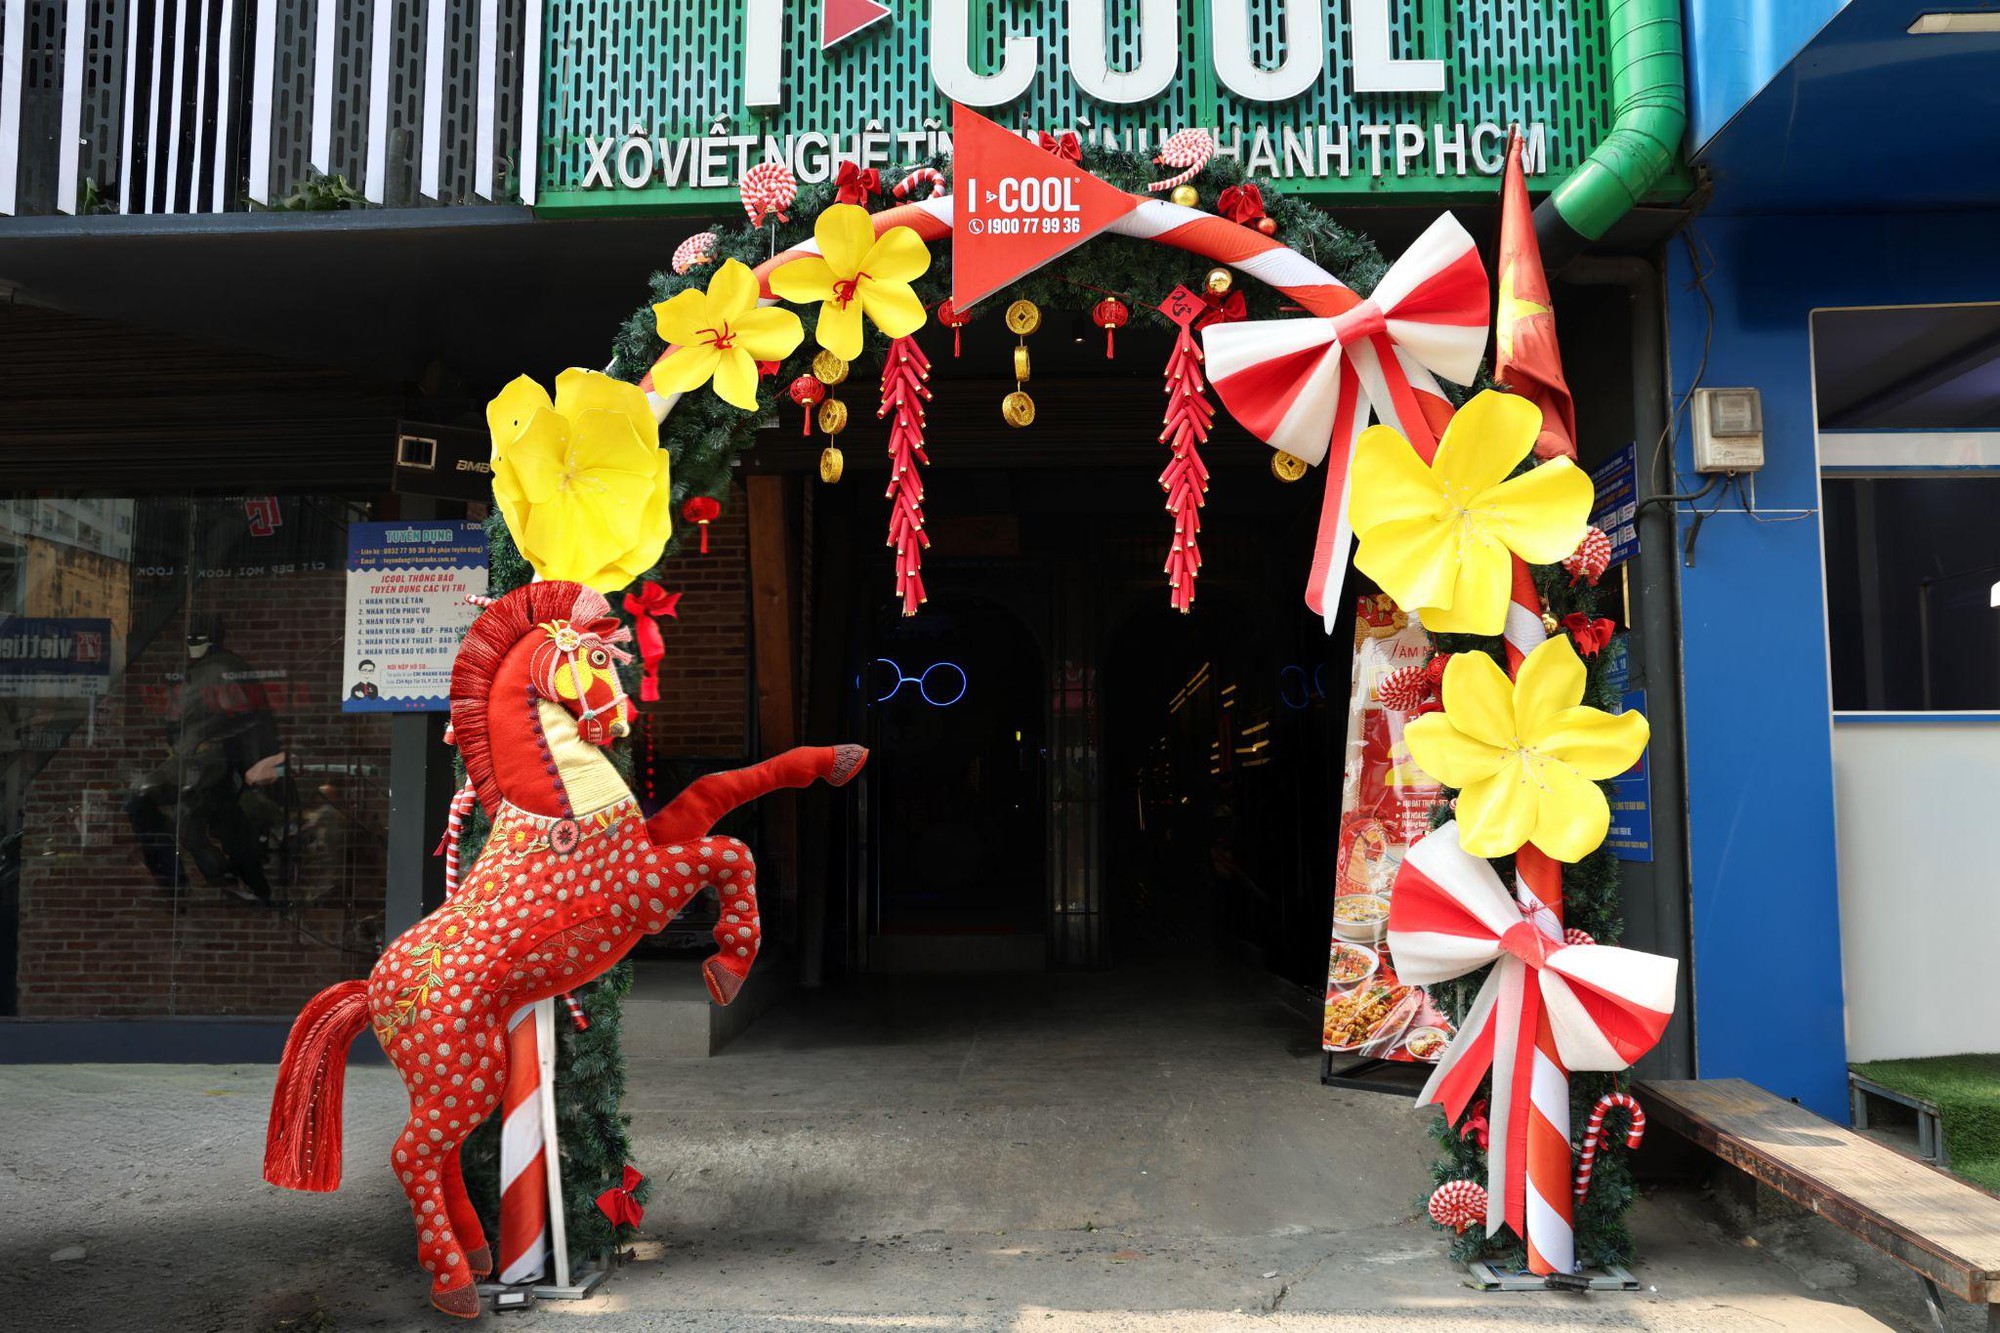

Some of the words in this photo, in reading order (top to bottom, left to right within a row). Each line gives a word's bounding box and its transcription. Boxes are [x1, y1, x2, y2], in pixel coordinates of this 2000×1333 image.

[582, 123, 653, 188] XÔ
[659, 112, 757, 188] VIẾT
[1360, 124, 1425, 176] TP
[968, 178, 976, 213] I
[988, 218, 1019, 234] 1900
[1022, 218, 1038, 234] 77
[1042, 218, 1058, 234] 99
[1063, 218, 1080, 234] 36
[386, 526, 421, 543] TUYỂN
[422, 528, 453, 544] DỤNG
